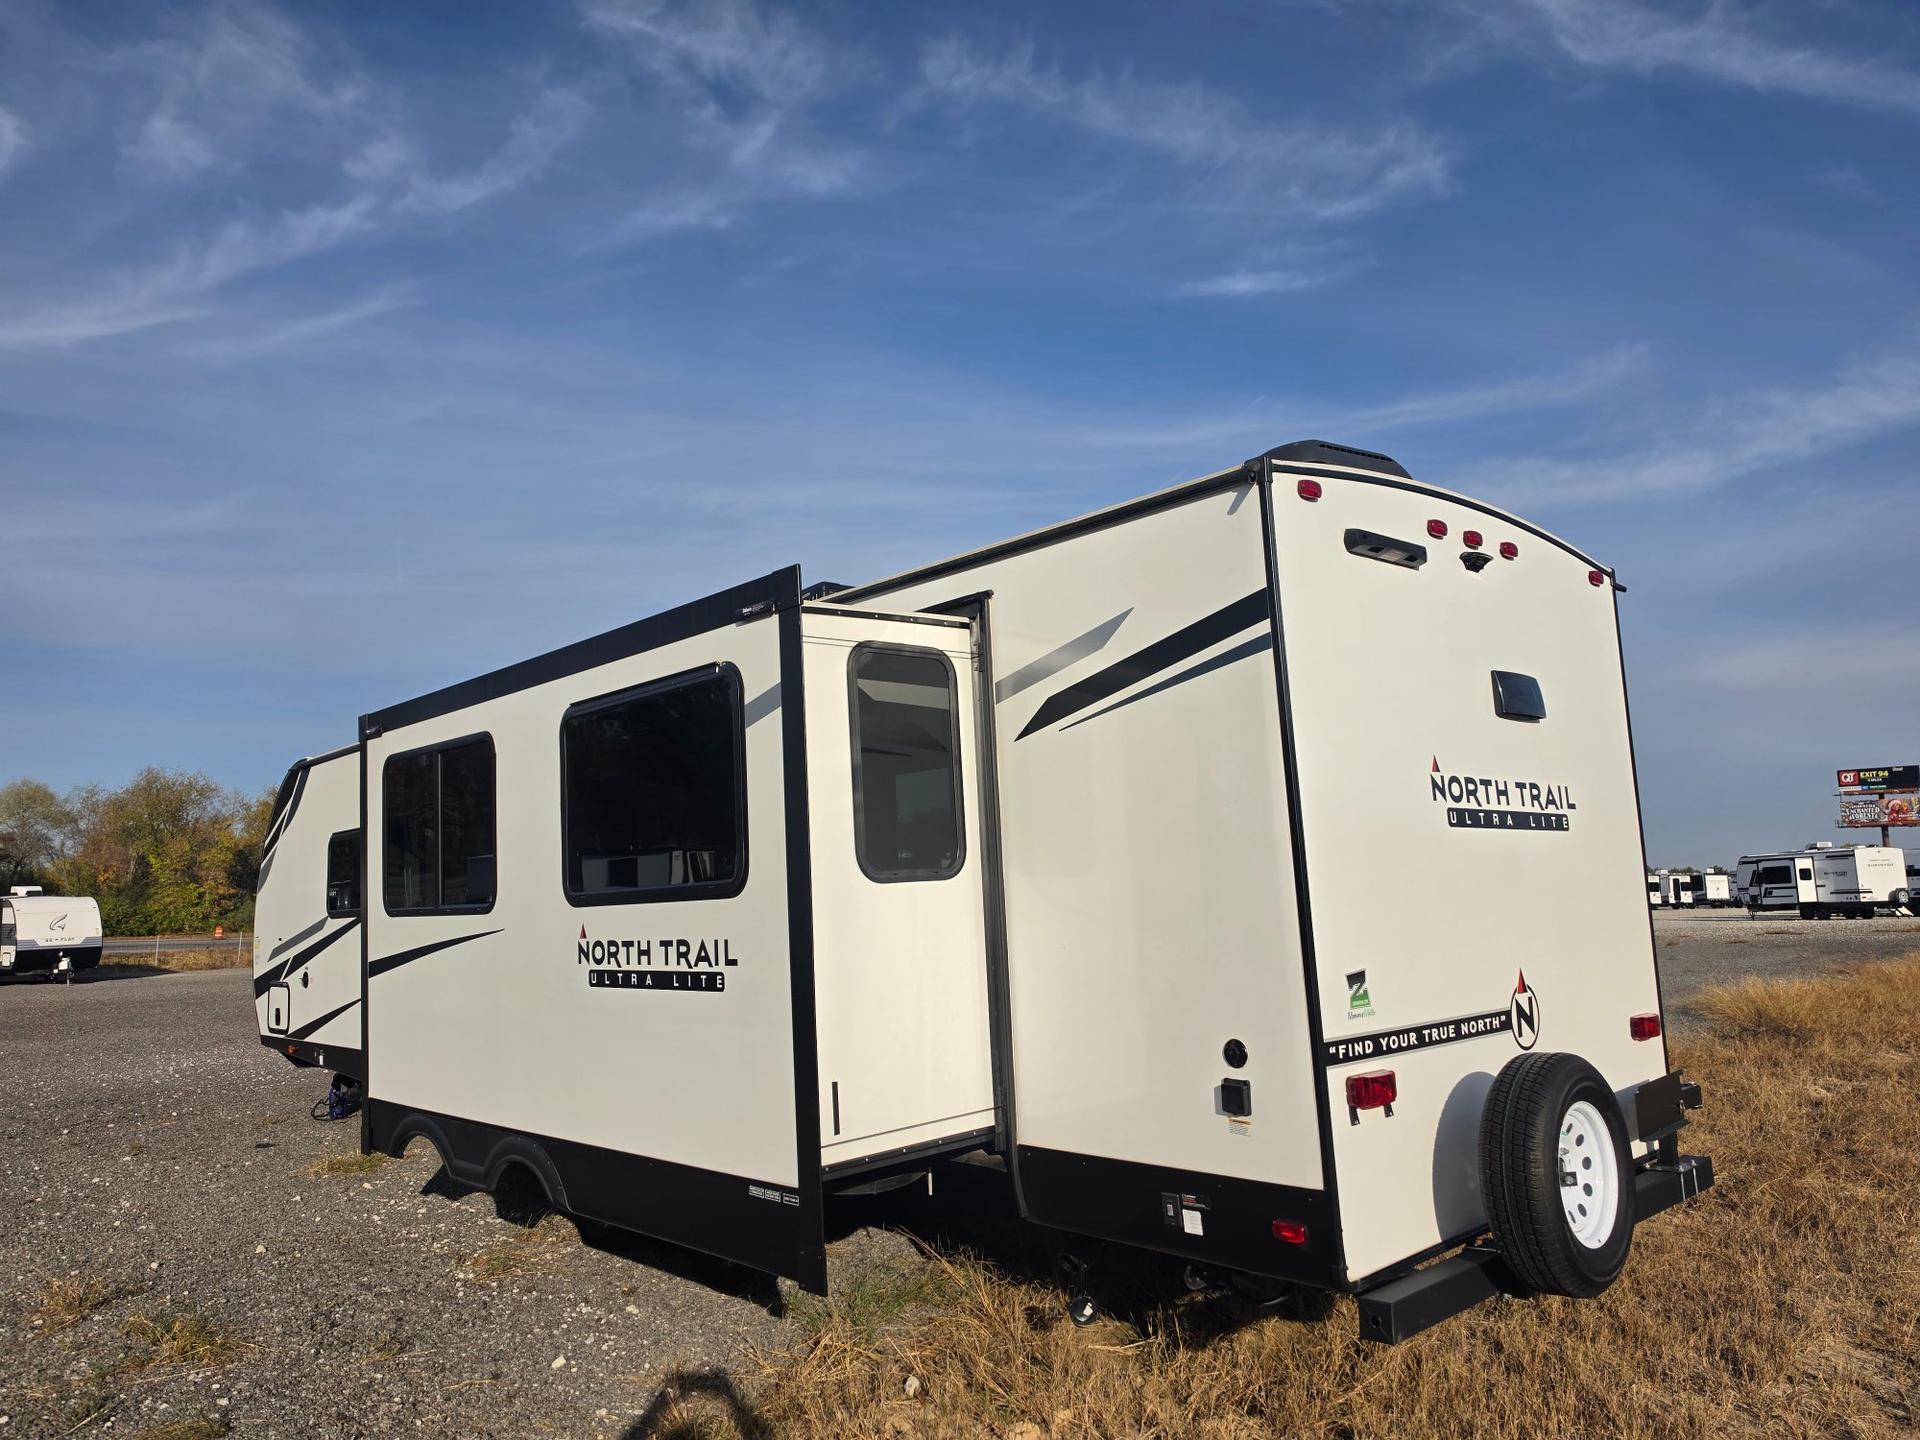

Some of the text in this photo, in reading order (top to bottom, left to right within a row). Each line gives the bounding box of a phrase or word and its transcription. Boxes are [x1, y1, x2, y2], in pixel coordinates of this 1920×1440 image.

[1841, 773, 1855, 783] QT
[1430, 774, 1576, 811] NORTH TRAIL
[1449, 811, 1568, 828] ULTRA LITE
[578, 938, 738, 969] NORTH TRAIL
[590, 972, 723, 988] ULTRA LITE
[1379, 1033, 1418, 1051] YOUR
[1422, 1025, 1456, 1041] TRUE
